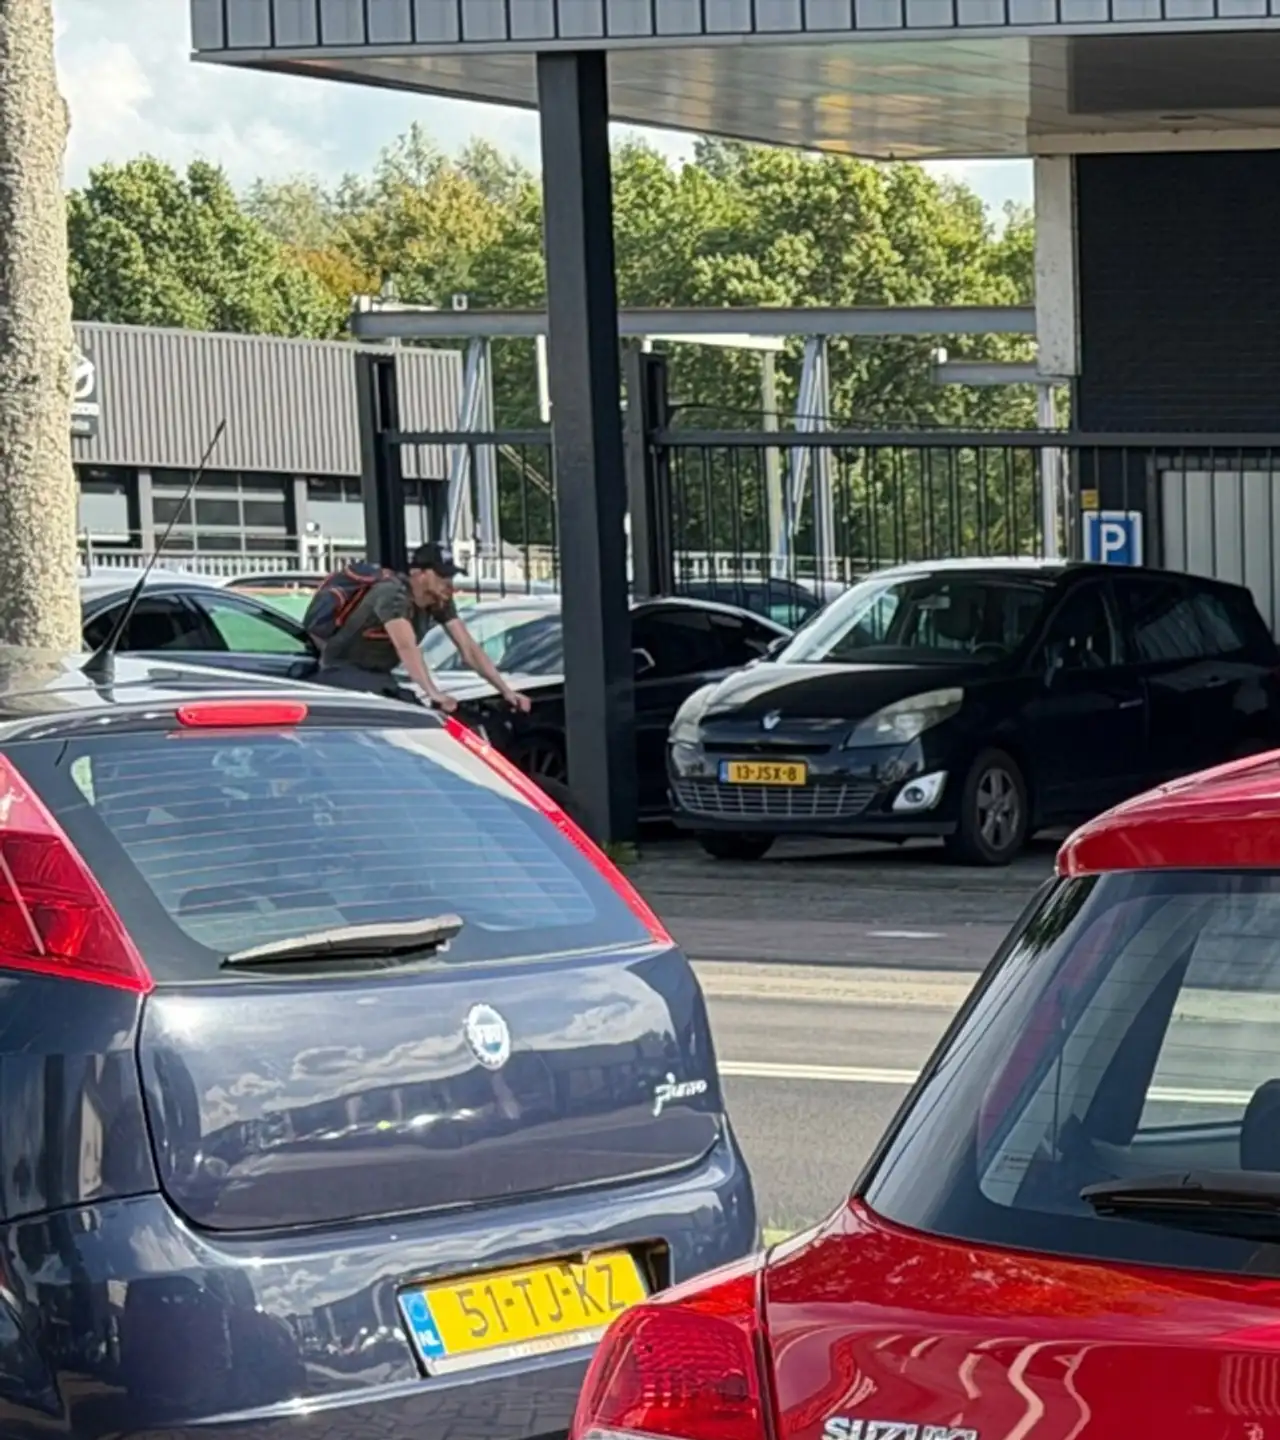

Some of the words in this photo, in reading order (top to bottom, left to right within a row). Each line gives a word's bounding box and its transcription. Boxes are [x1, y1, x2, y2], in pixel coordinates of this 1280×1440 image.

[1101, 523, 1126, 565] P
[455, 1263, 625, 1338] 51-TJ-KZ
[418, 1329, 440, 1347] NL
